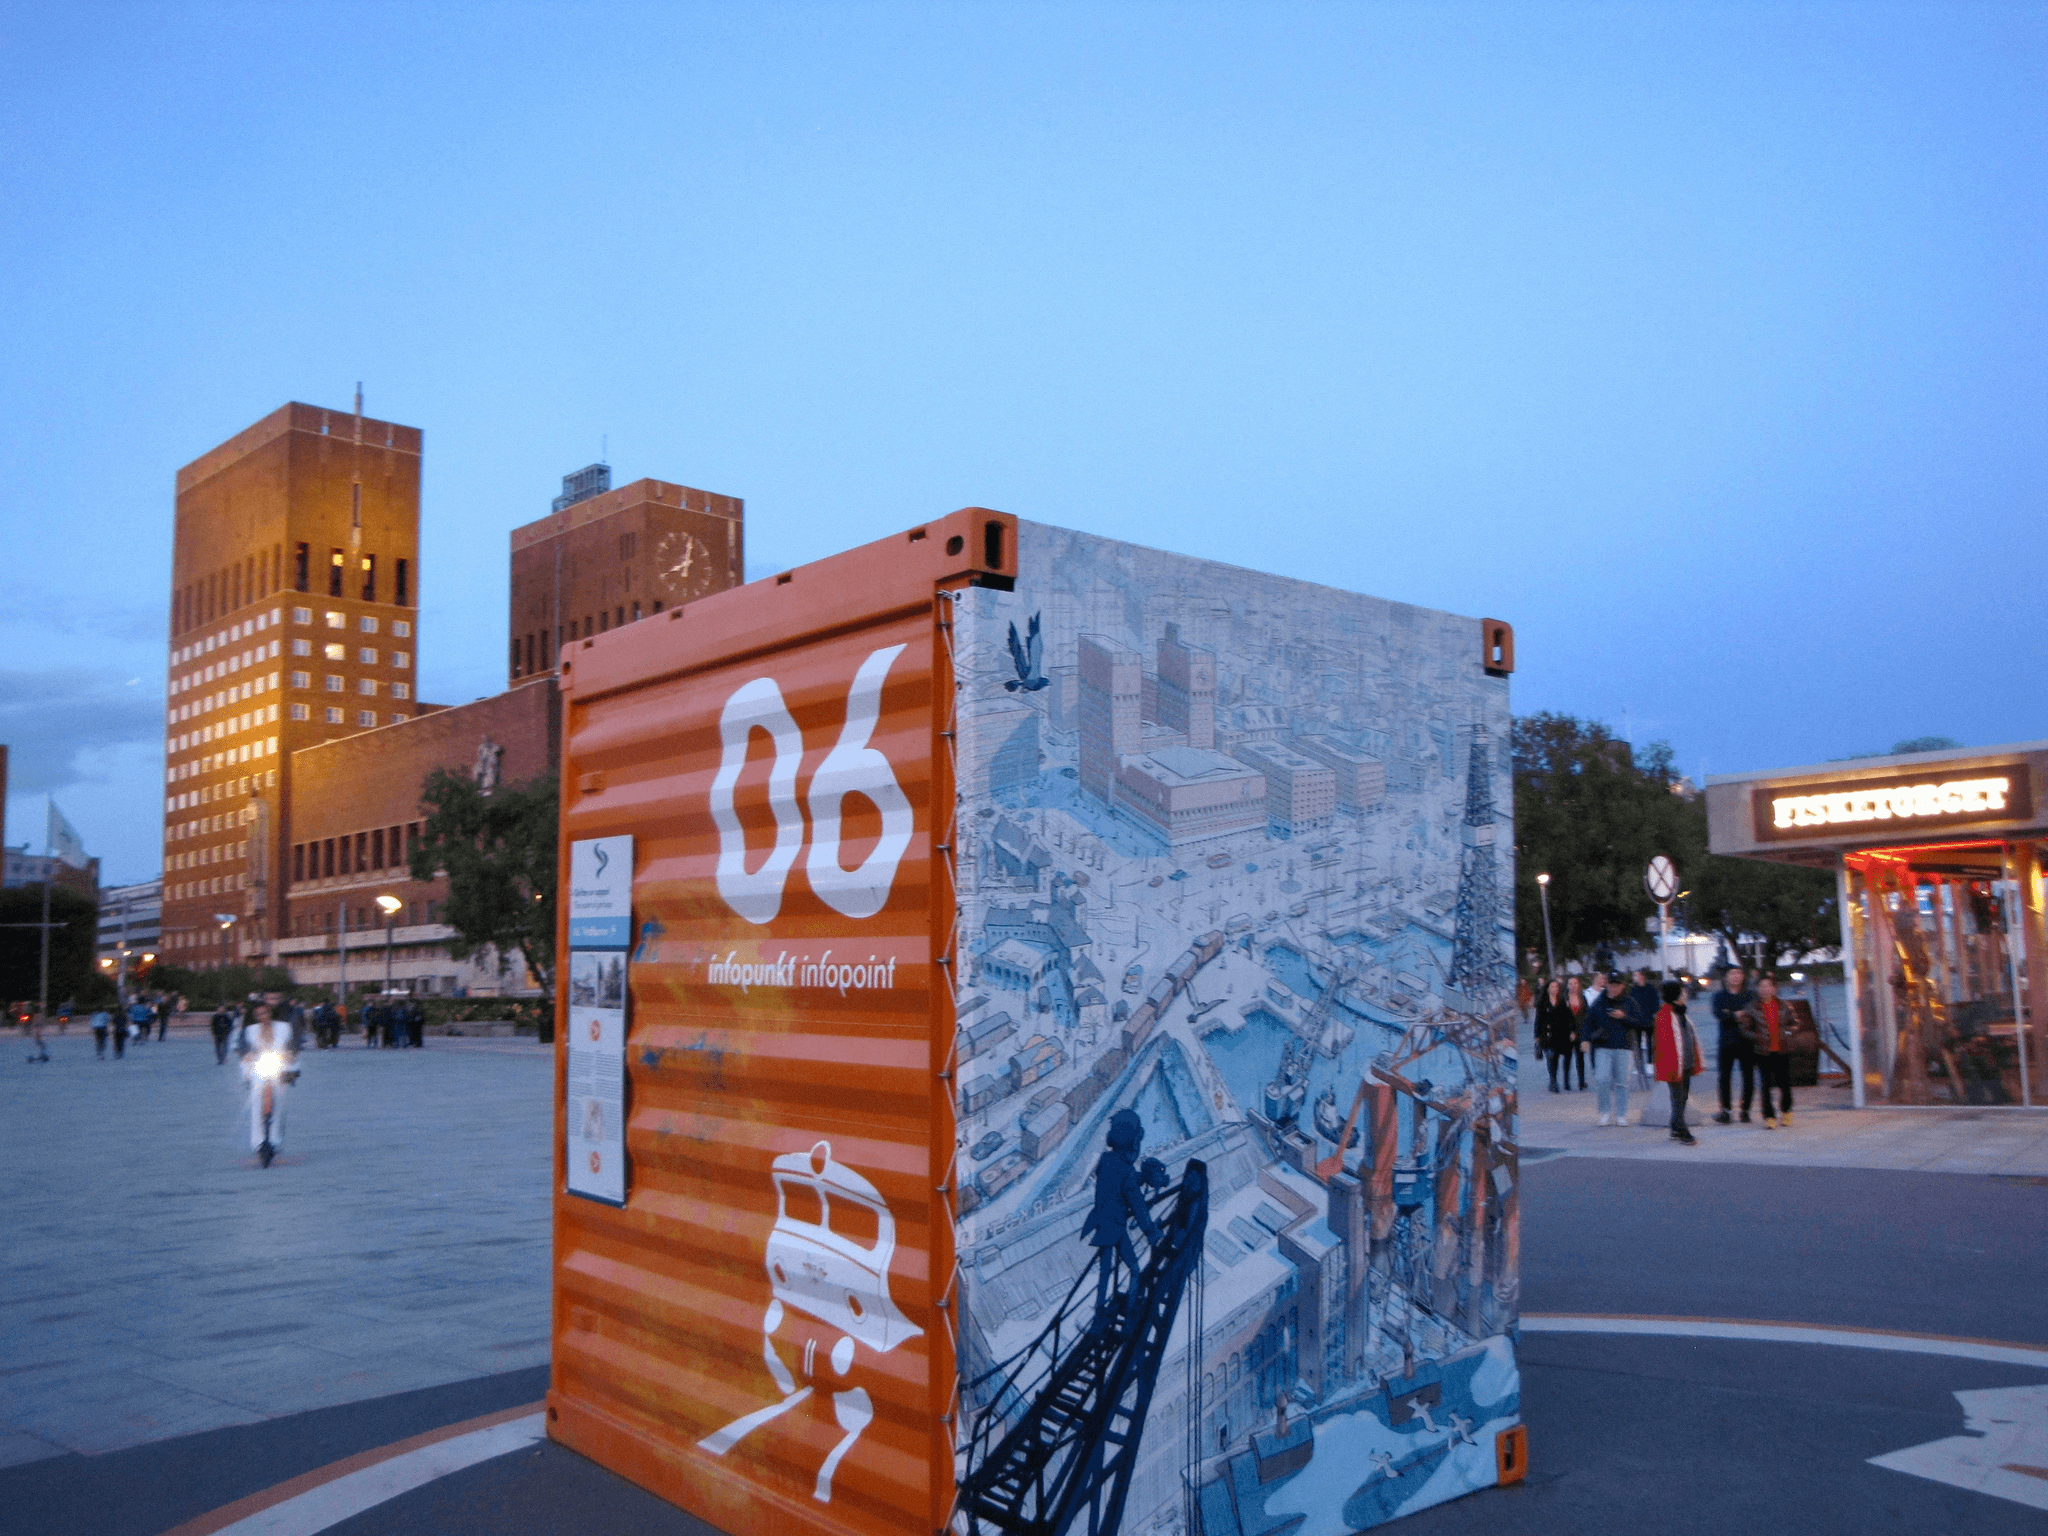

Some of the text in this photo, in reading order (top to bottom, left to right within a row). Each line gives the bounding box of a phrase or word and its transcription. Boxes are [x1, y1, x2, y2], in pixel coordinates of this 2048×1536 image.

[710, 643, 914, 924] 06
[708, 950, 897, 998] infopunkt infopoint
